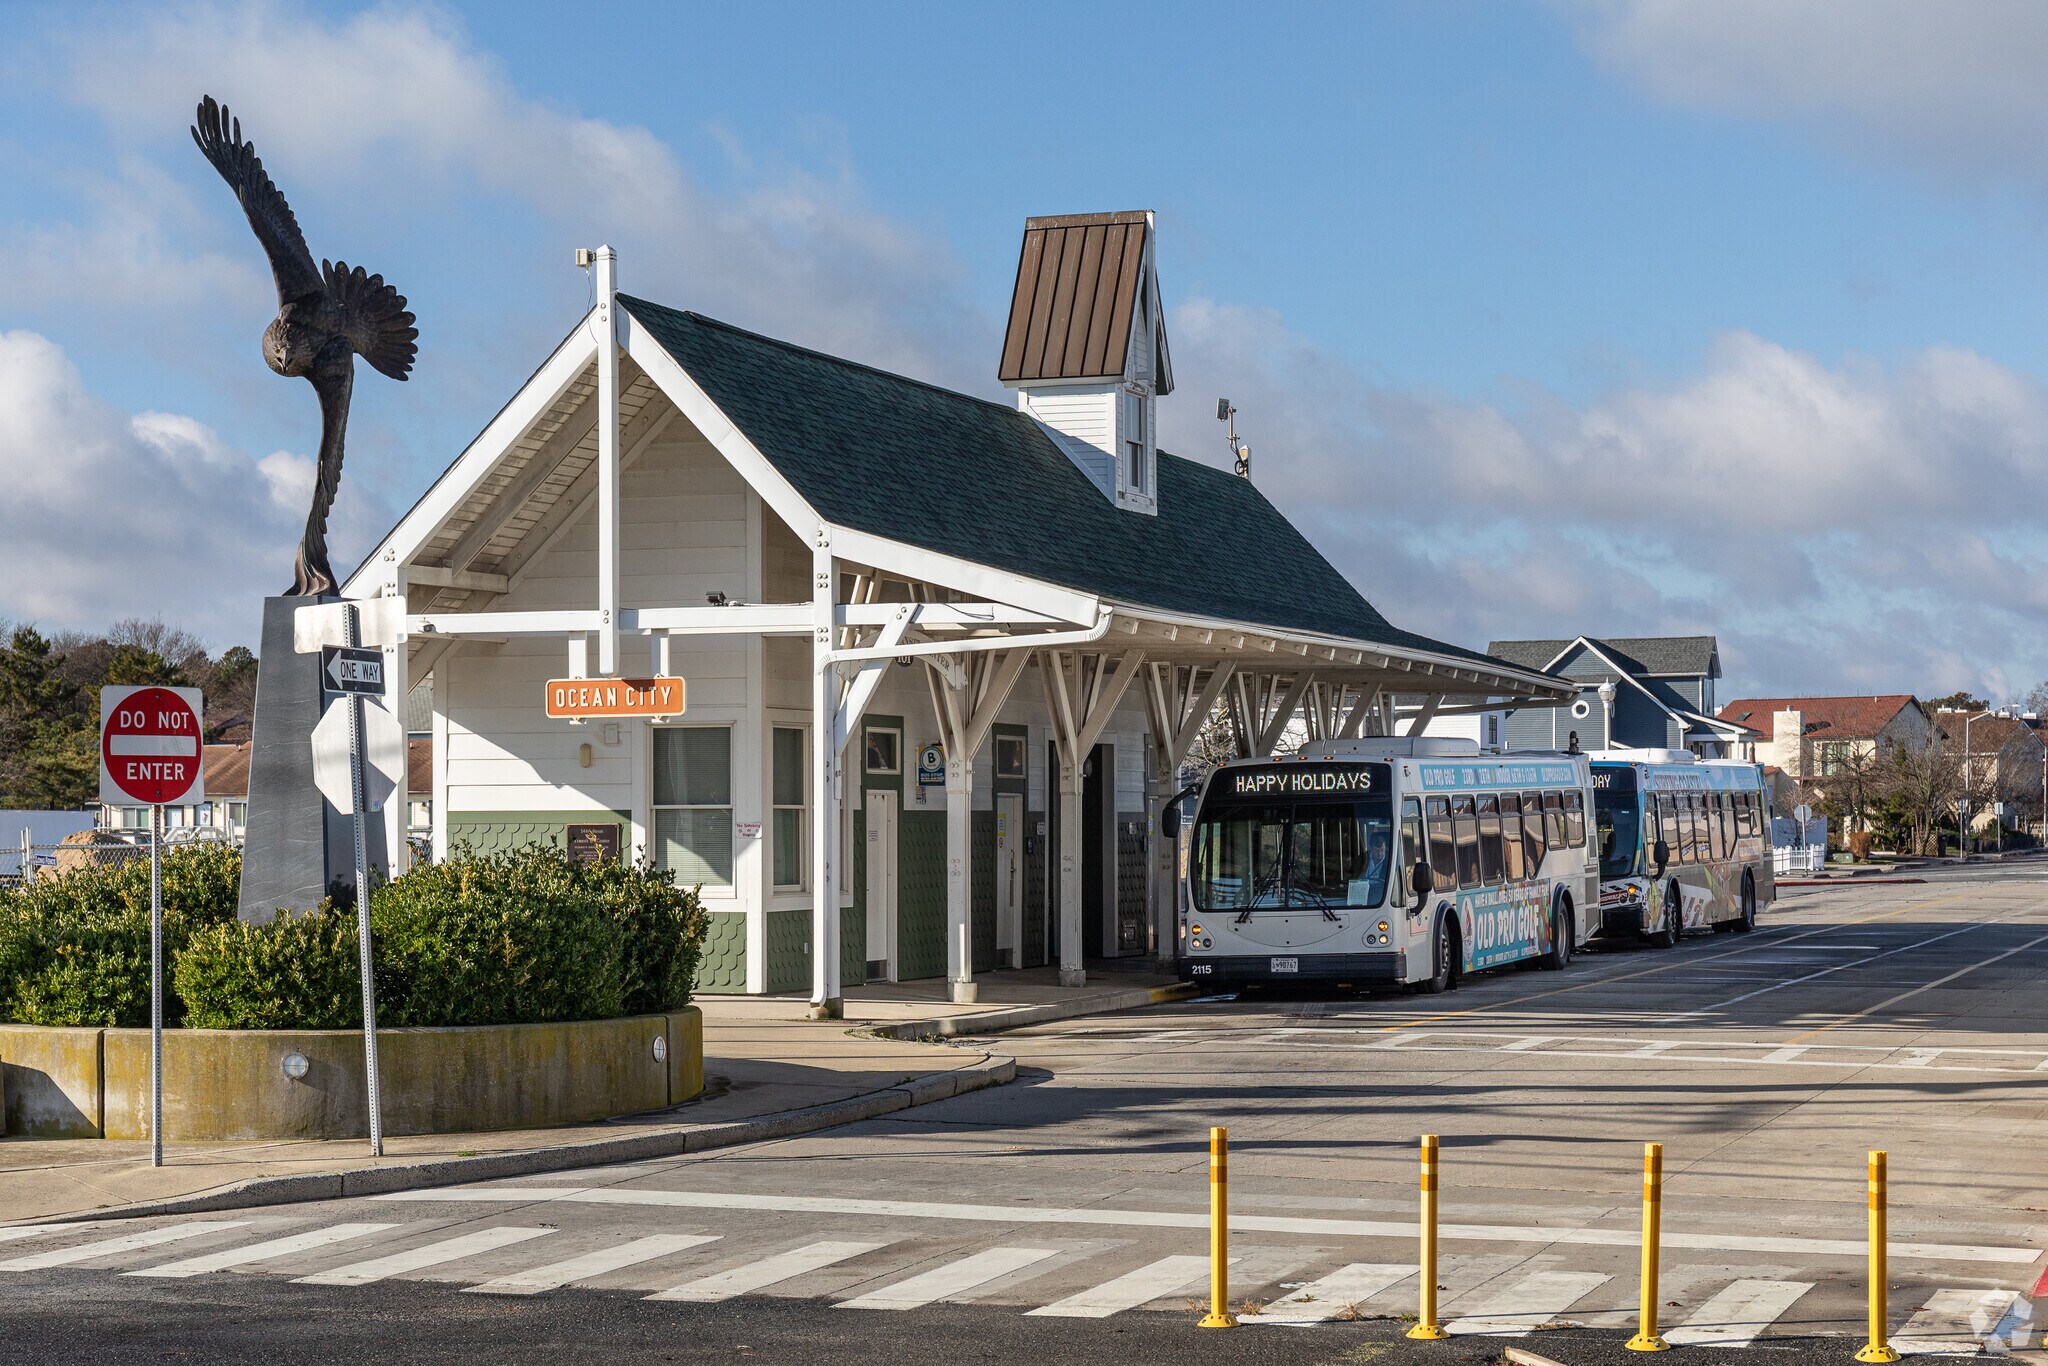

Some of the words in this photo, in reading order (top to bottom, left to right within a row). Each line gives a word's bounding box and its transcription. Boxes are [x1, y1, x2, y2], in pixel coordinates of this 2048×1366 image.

[340, 661, 358, 679] ONE
[362, 663, 379, 681] WAY
[555, 687, 618, 708] OCEAN
[625, 686, 672, 706] CITY
[120, 710, 145, 729] DO
[158, 711, 189, 729] NOT
[927, 752, 936, 763] B
[127, 762, 184, 780] ENTER
[1423, 768, 1434, 786] OLD
[1433, 768, 1444, 786] PRO
[1443, 768, 1455, 786] GOLF
[1236, 774, 1288, 792] HAPPY
[1292, 772, 1371, 791] HOLIDAYS
[1477, 912, 1495, 951] OLD
[1497, 908, 1515, 947] PRO
[1518, 904, 1539, 942] GOLF
[1191, 965, 1212, 975] 2115
